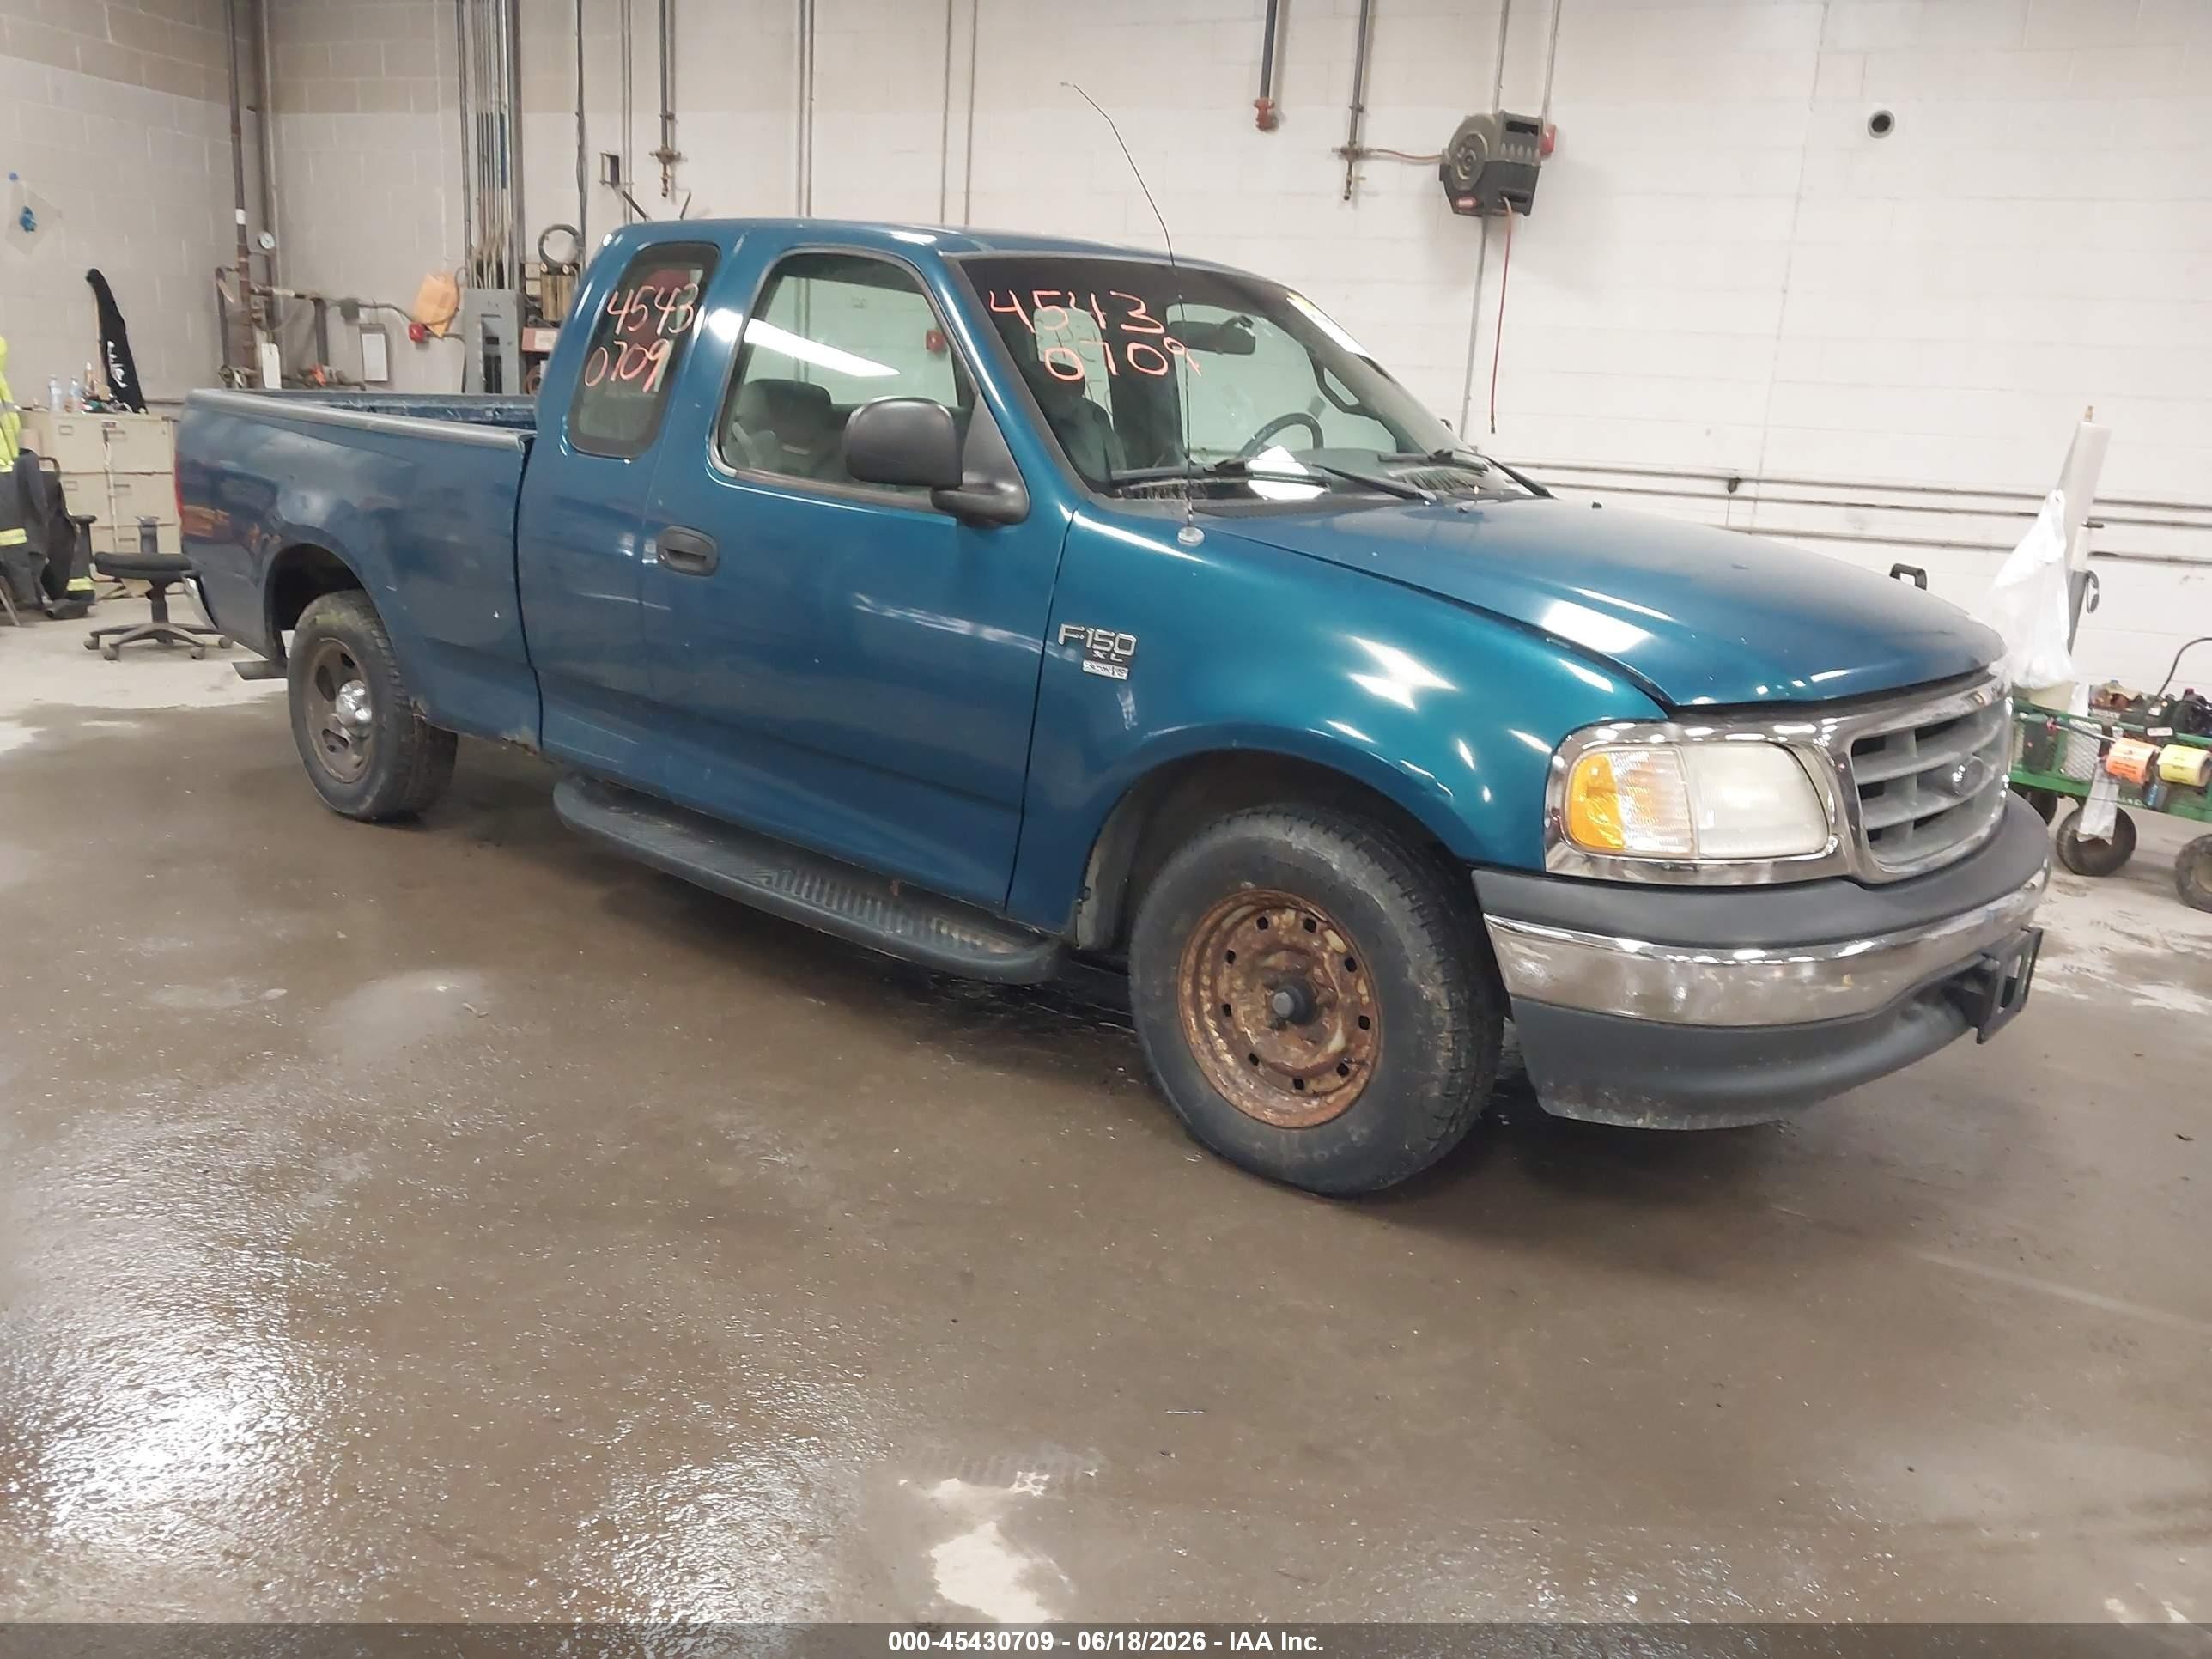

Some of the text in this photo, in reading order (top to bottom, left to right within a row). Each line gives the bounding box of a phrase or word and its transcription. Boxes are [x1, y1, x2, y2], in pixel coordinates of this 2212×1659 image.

[606, 285, 699, 335] 4543
[989, 289, 1165, 334] 4543
[585, 338, 670, 392] 0709
[1043, 337, 1202, 380] 0709
